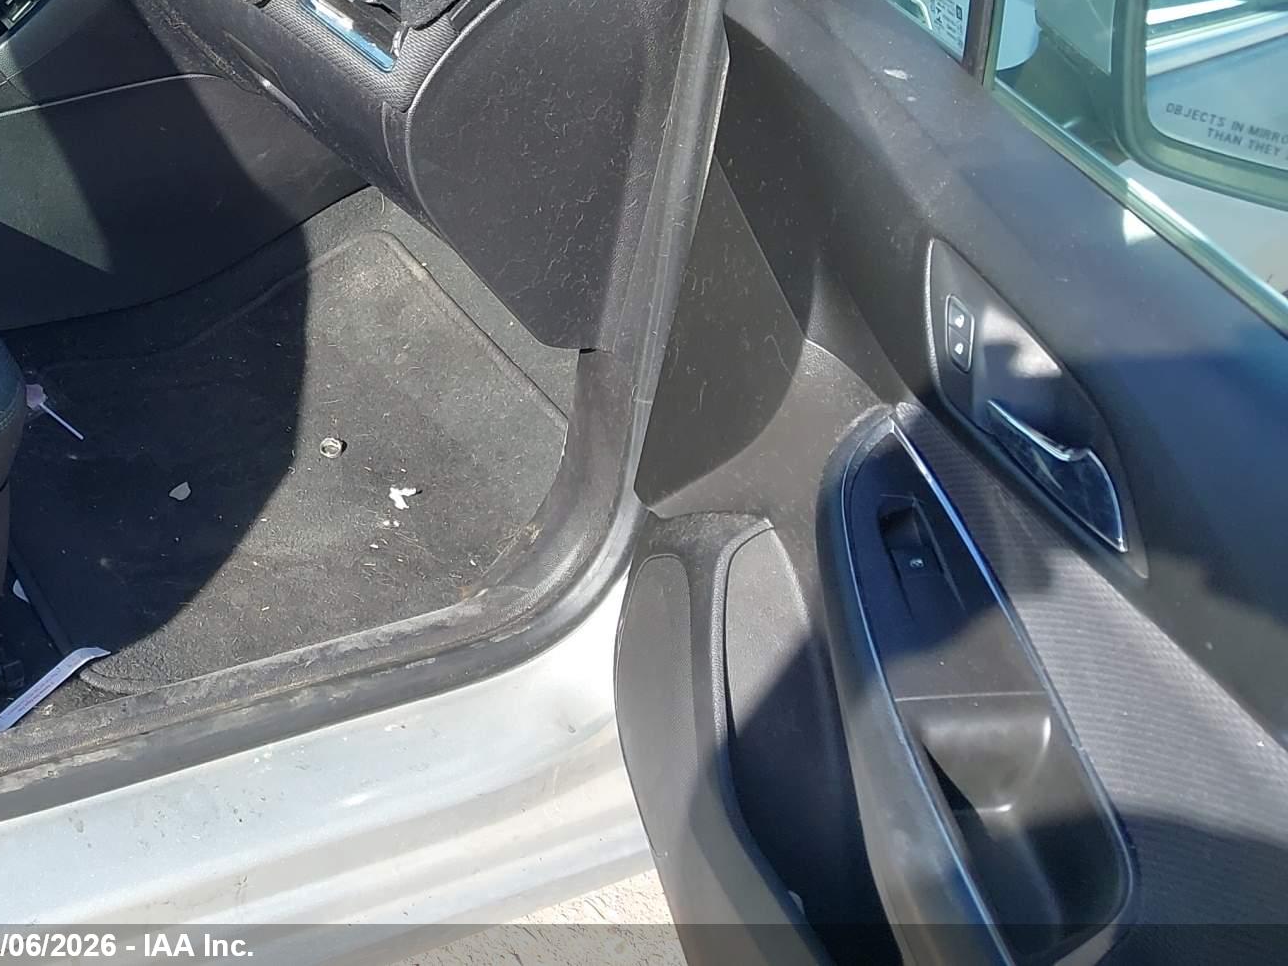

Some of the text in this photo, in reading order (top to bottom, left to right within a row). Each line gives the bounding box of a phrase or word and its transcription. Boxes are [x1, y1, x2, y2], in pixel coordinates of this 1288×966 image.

[1165, 102, 1227, 128] OBJECTS
[1231, 120, 1245, 133] IN
[1207, 127, 1244, 146] THAN
[1248, 139, 1282, 157] THEY
